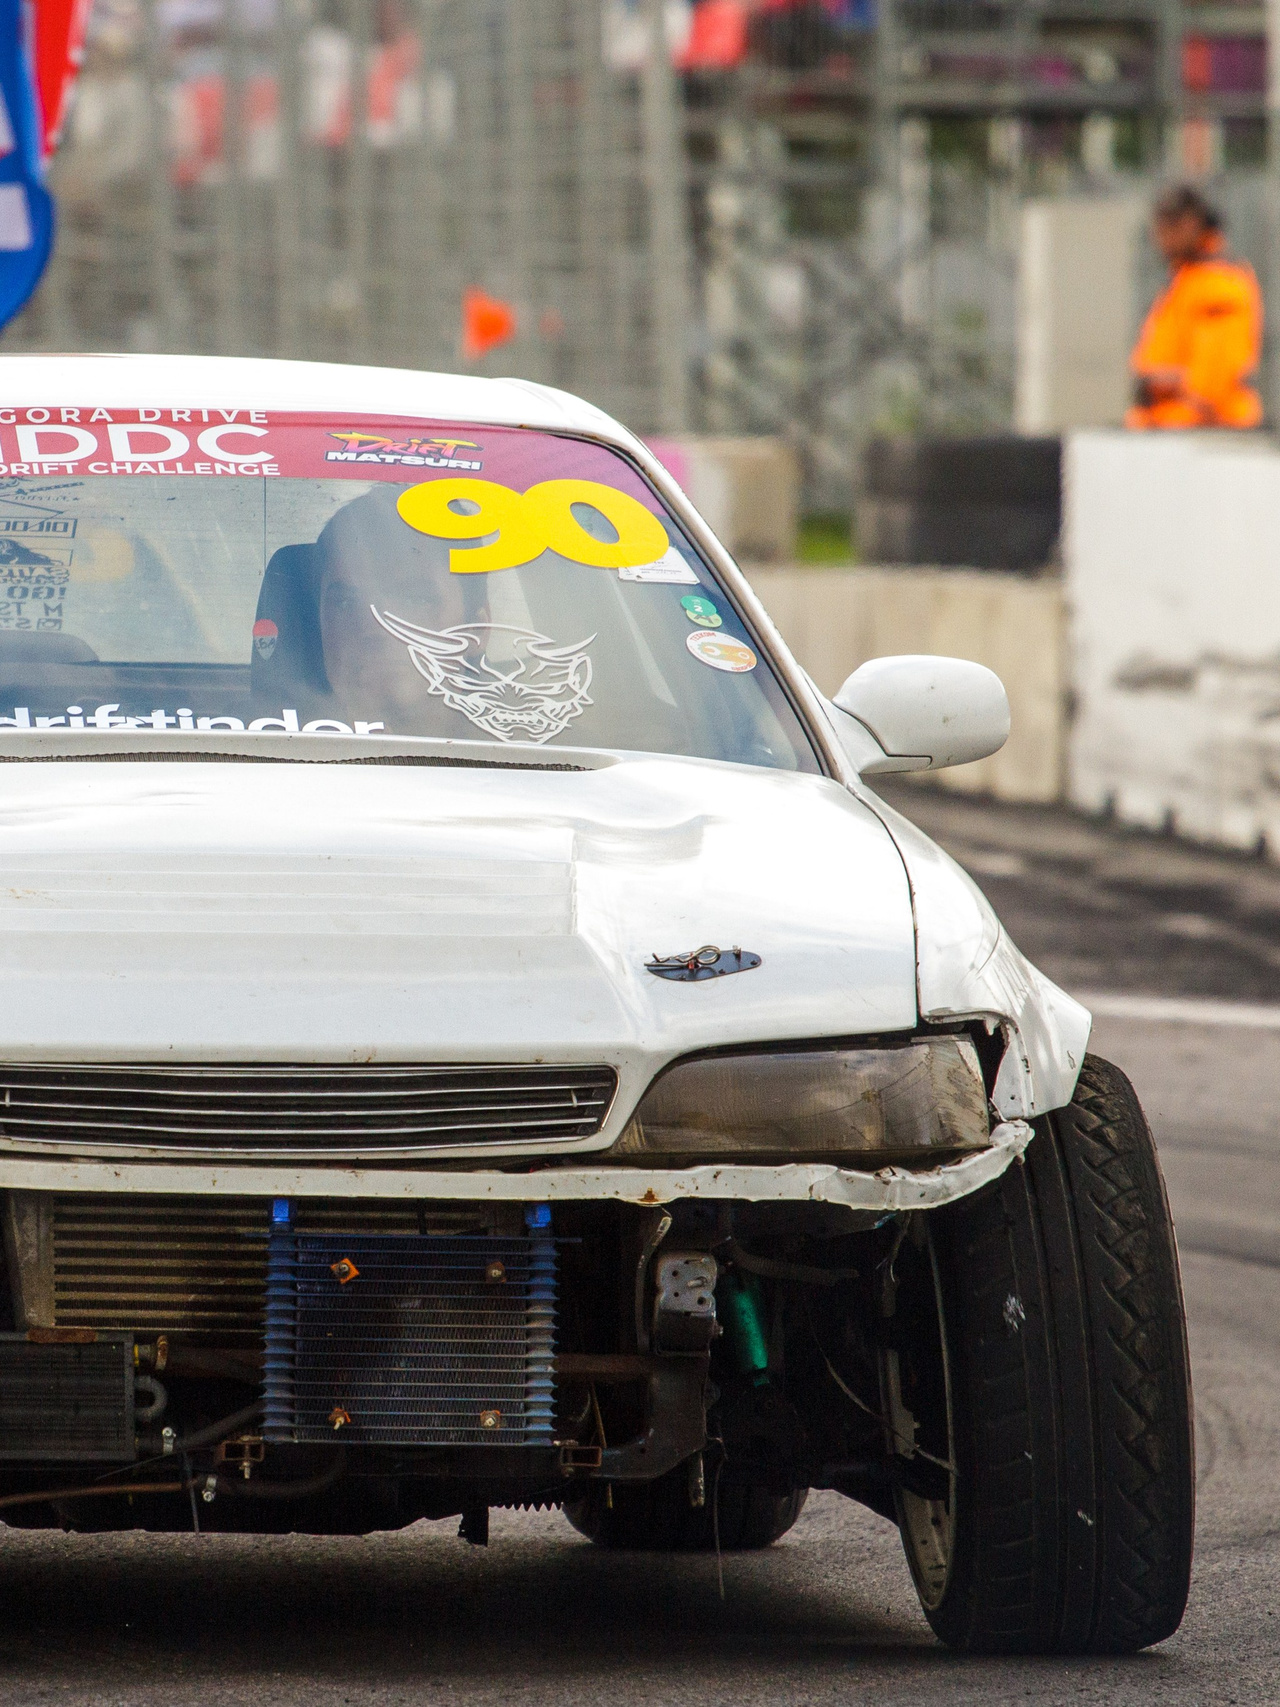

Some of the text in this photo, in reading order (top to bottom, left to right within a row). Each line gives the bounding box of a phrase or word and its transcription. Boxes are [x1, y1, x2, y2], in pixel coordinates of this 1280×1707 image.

[138, 408, 269, 424] DRIVE
[87, 461, 282, 476] CHALLENGE
[325, 451, 482, 471] MATSURI
[396, 478, 669, 574] 90
